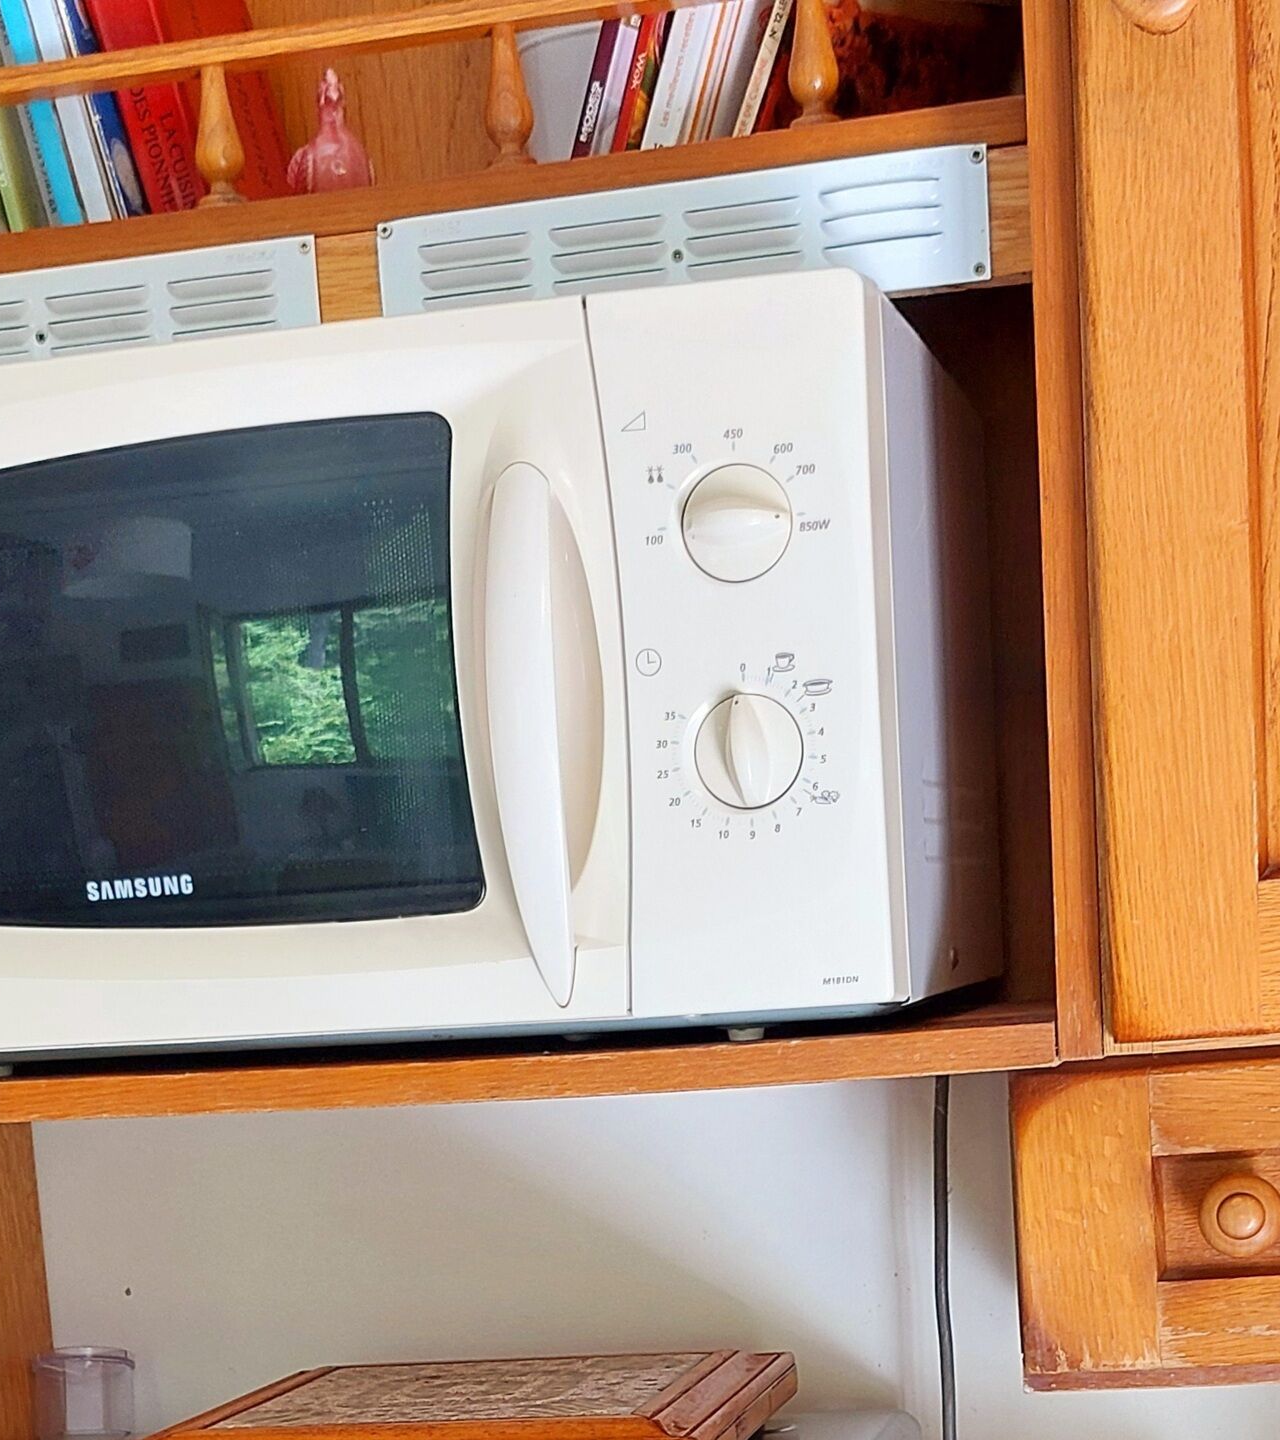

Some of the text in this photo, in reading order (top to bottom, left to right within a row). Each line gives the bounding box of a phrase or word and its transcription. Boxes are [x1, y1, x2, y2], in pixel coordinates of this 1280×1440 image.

[660, 111, 670, 128] Les
[681, 12, 695, 54] recettes
[160, 112, 177, 142] LA
[723, 427, 743, 440] 450
[672, 443, 692, 455] 300
[773, 441, 793, 455] 600
[795, 463, 815, 476] 700
[799, 517, 830, 533] 850W
[645, 534, 663, 547] 100
[739, 663, 746, 674] 0
[766, 666, 771, 677] 1
[791, 679, 798, 690] 2
[809, 702, 816, 713] 3
[664, 711, 677, 722] 35
[818, 726, 824, 737] 4
[655, 739, 668, 750] 30
[820, 753, 827, 764] 5
[656, 768, 669, 780] 25
[812, 781, 818, 792] 6
[668, 796, 681, 808] 20
[796, 806, 802, 817] 7
[690, 817, 702, 829] 15
[774, 823, 781, 834] 8
[718, 829, 730, 840] 10
[749, 829, 756, 840] 9
[86, 874, 194, 901] SAMSUNG
